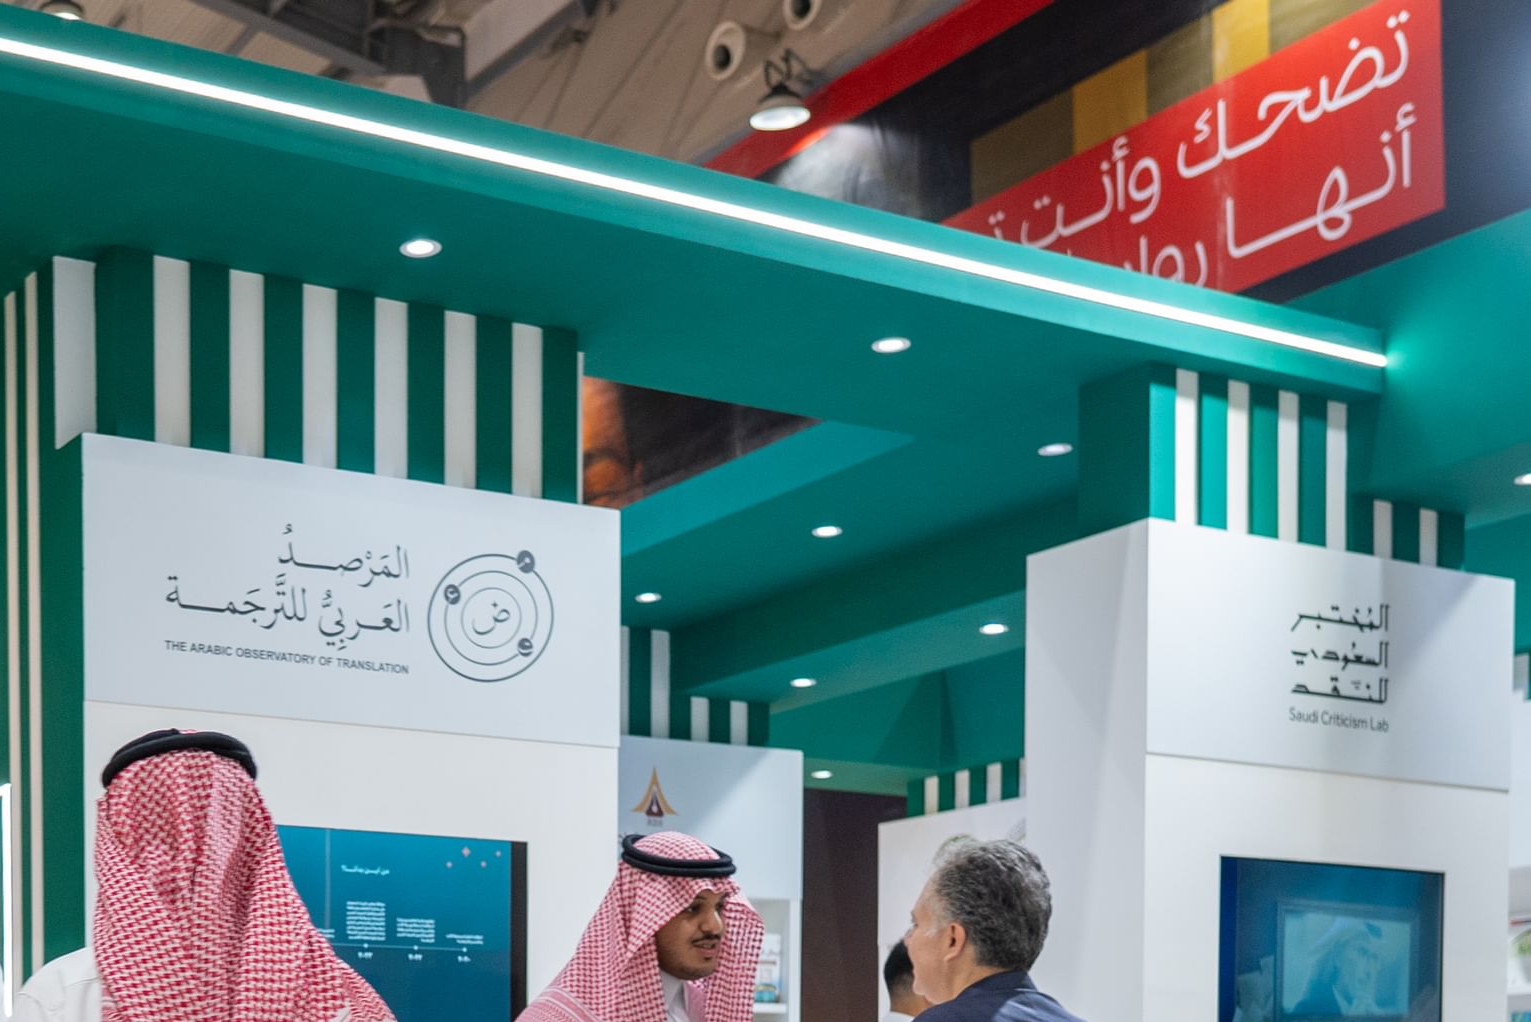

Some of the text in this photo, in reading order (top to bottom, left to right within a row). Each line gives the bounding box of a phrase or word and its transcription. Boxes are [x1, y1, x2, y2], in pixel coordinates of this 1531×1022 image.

[1020, 9, 1411, 249] تضحك وأنت
[1224, 101, 1417, 259] أنها
[164, 639, 410, 675] THE ARABIC OBSERVATORY OF TRANSLATION
[1288, 706, 1390, 733] Saudi Criticism Lab
